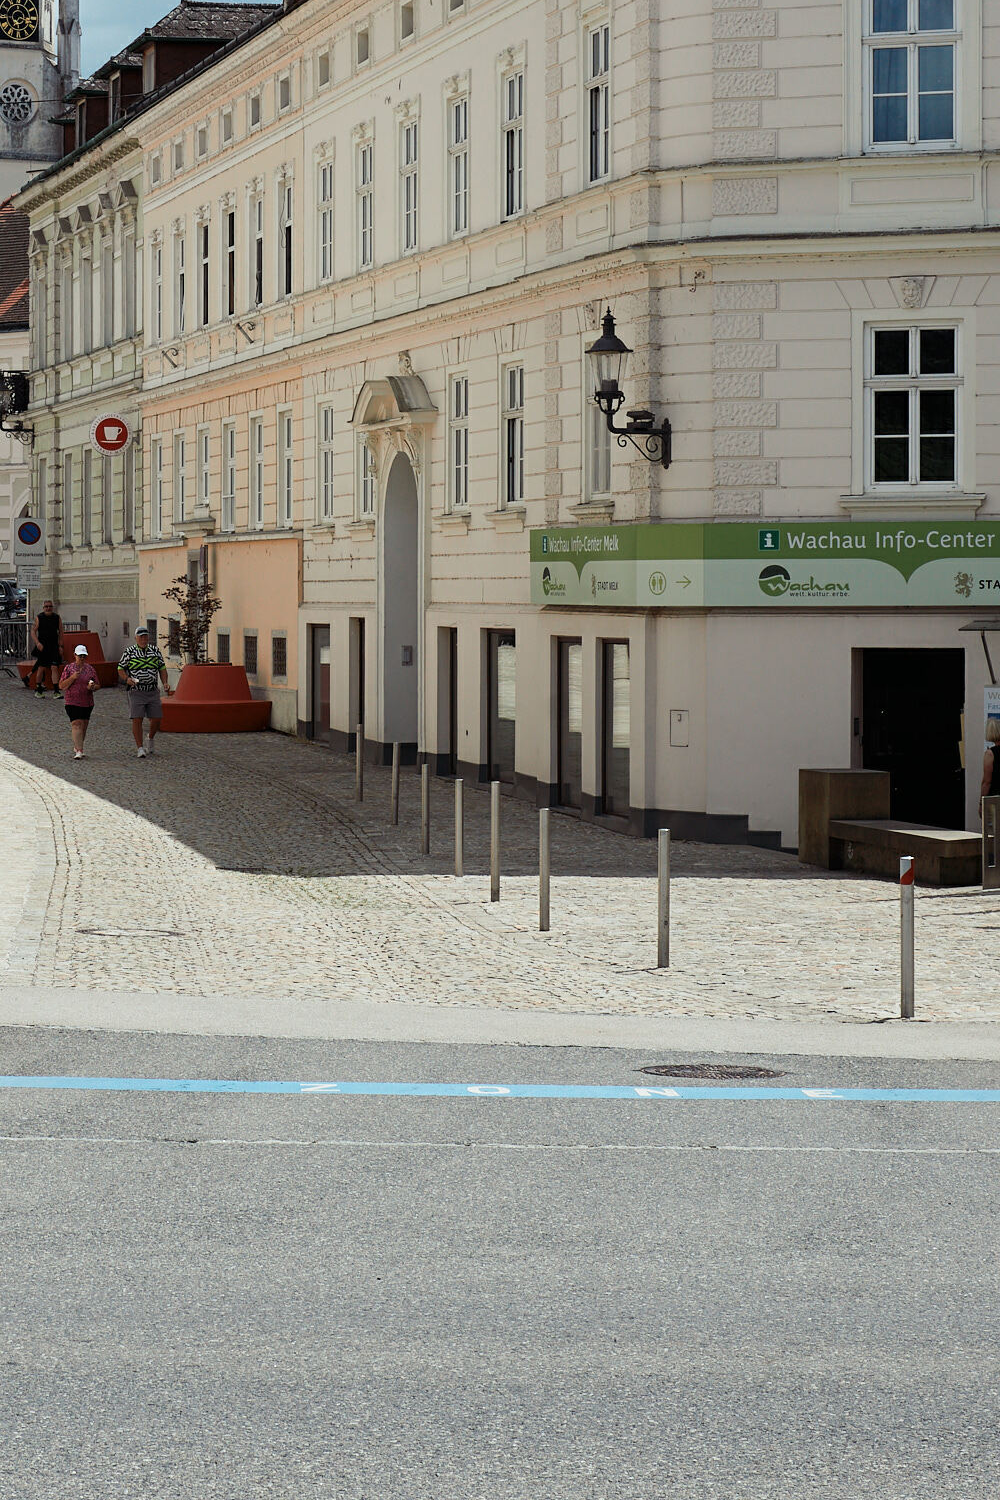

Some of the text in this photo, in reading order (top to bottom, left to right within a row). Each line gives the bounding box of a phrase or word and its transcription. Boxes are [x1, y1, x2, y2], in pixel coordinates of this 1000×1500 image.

[549, 535, 569, 552] Wachau
[570, 535, 602, 555] Info-Center
[603, 534, 618, 550] Melk
[786, 531, 867, 549] Wachau
[876, 530, 996, 553] Info-Center
[768, 575, 850, 591] Wachau
[979, 579, 1000, 590] STA
